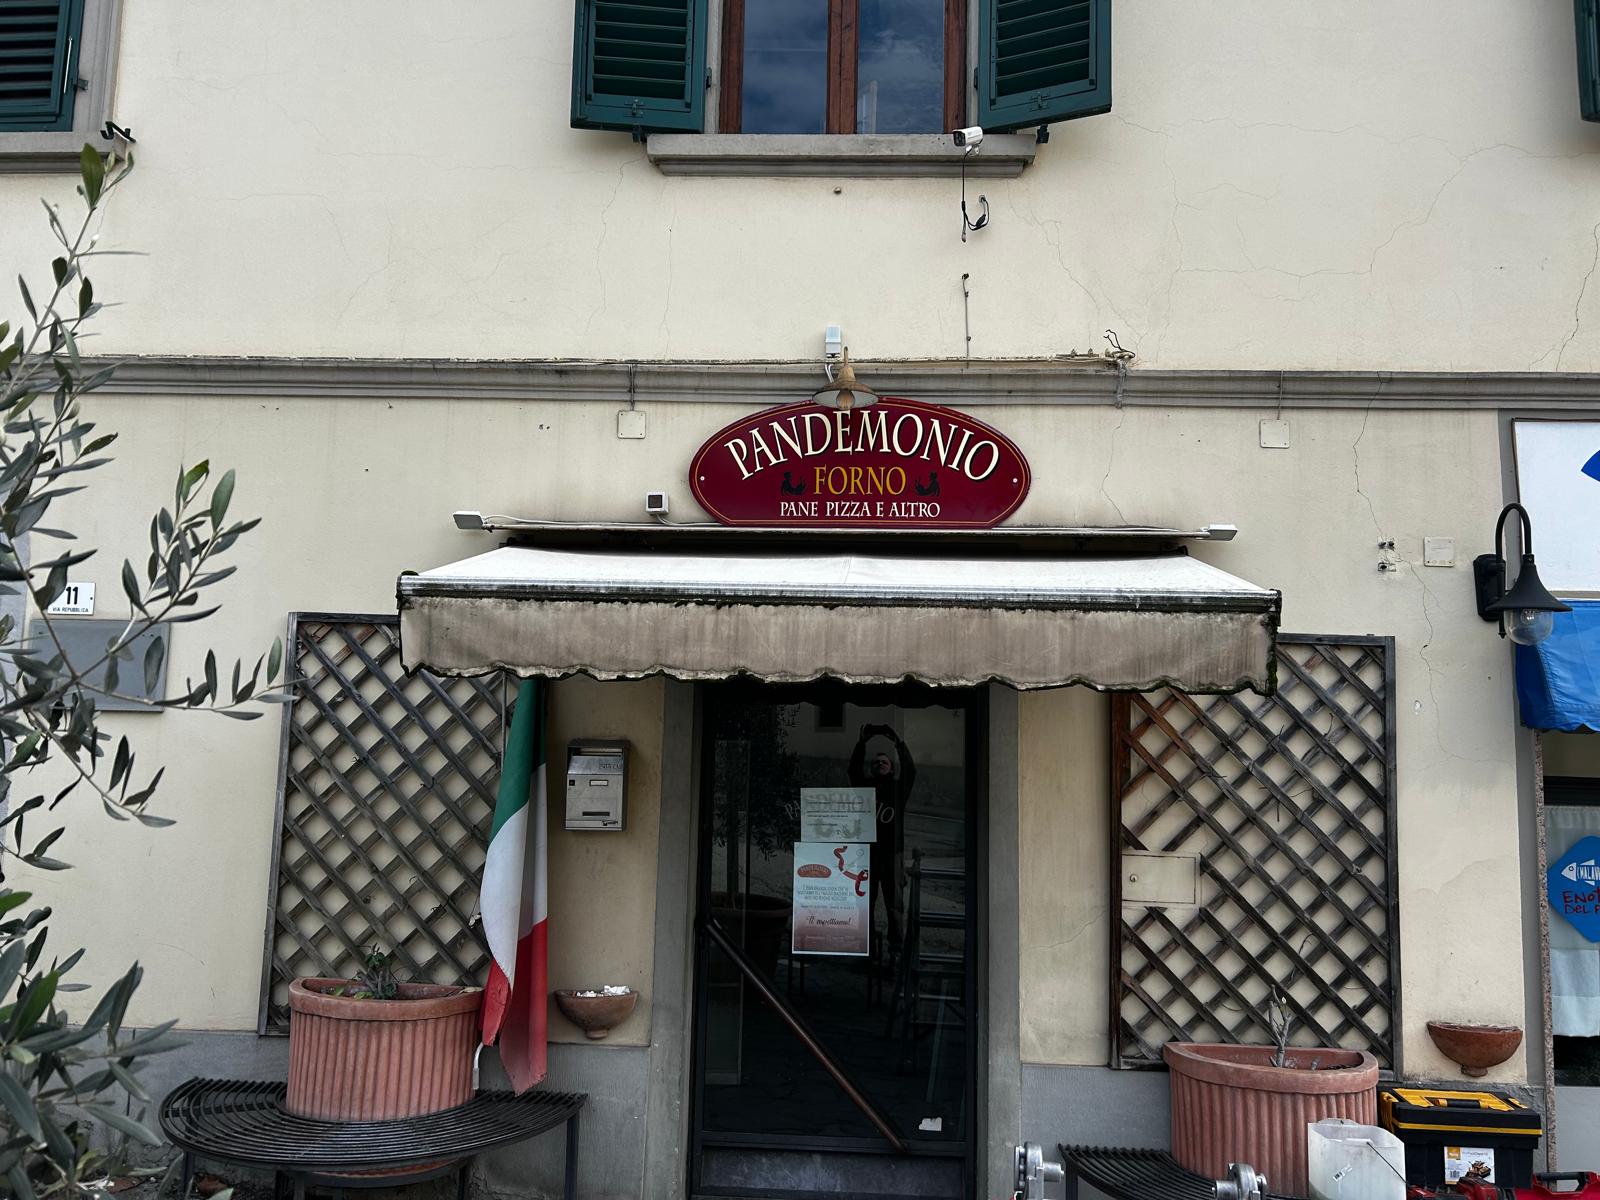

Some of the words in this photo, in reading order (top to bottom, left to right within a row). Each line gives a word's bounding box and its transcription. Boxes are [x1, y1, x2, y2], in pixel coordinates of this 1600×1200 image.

[724, 409, 1001, 482] PANDEMONIO
[813, 464, 907, 496] FORNO
[779, 501, 819, 518] PANE
[826, 501, 871, 518] PIZZA
[876, 502, 884, 518] E
[889, 501, 941, 519] ALTRO
[66, 586, 79, 605] 11
